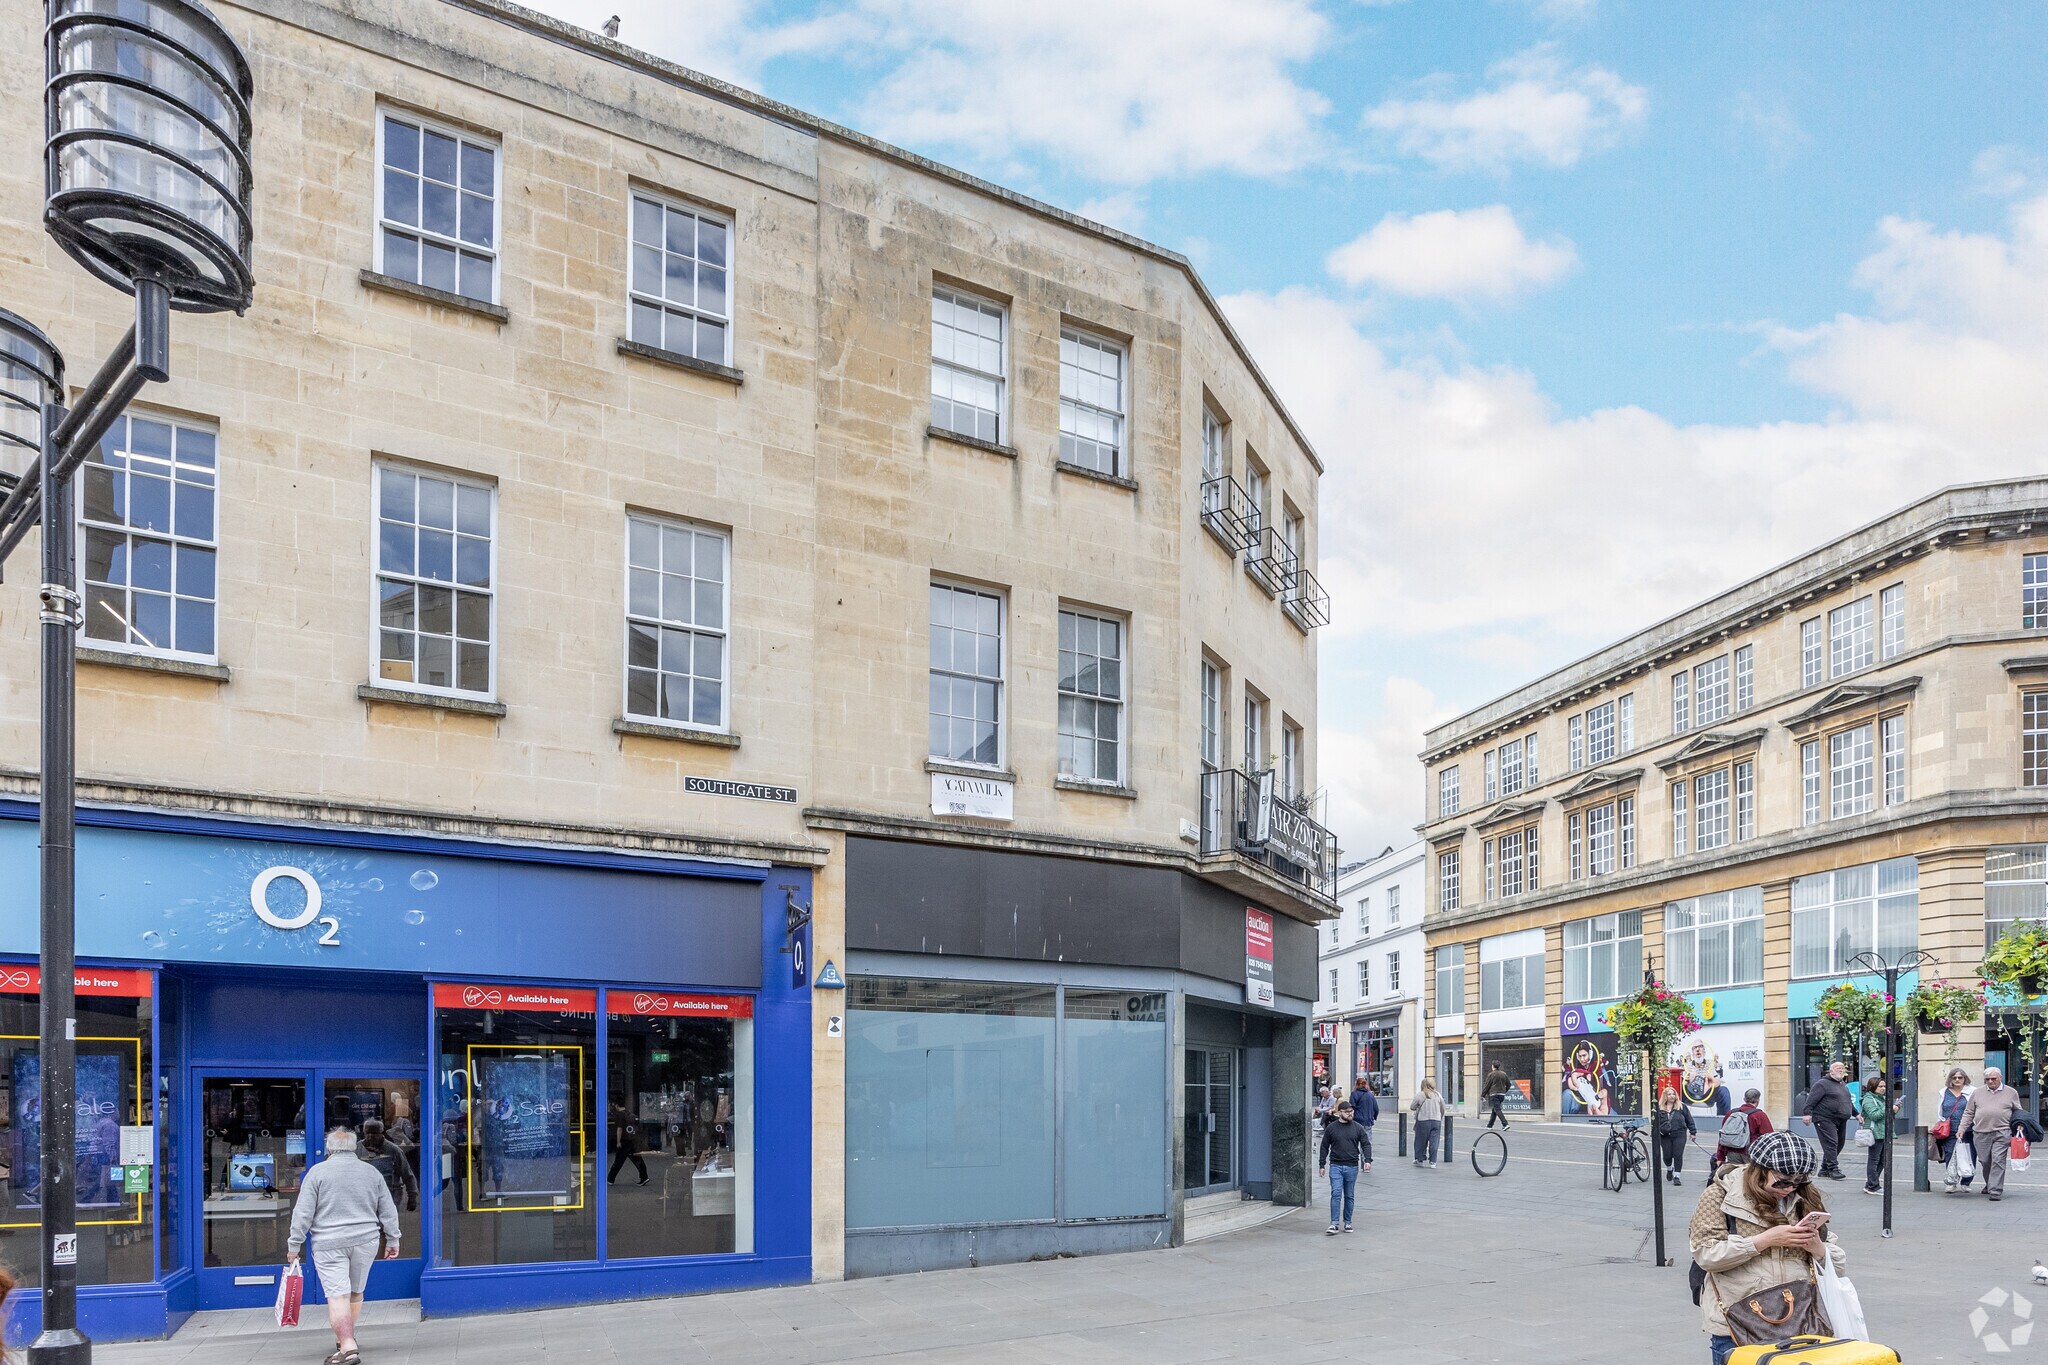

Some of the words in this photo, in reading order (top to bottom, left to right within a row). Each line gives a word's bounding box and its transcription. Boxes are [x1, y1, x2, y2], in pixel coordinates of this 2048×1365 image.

[689, 779, 771, 799] SOUTHGATE
[1270, 804, 1291, 836] AIR
[1293, 817, 1321, 854] ZONE
[250, 866, 340, 946] O2
[1249, 916, 1269, 934] auction
[794, 941, 804, 975] O2
[93, 978, 119, 987] here
[465, 989, 482, 1003] Virgin
[1257, 983, 1273, 1000] allsop
[507, 994, 548, 1004] Available
[550, 996, 569, 1005] here
[635, 997, 651, 1010] Virgin
[673, 1001, 709, 1010] Available
[710, 1002, 729, 1010] here
[1368, 1020, 1379, 1029] KFC
[1566, 1016, 1577, 1025] BT
[1732, 1050, 1745, 1060] YOUR
[1745, 1049, 1759, 1059] HOME
[1728, 1060, 1741, 1070] RUNS
[1741, 1059, 1763, 1069] SMARTER
[77, 1098, 116, 1116] ale
[520, 1099, 563, 1117] Sale
